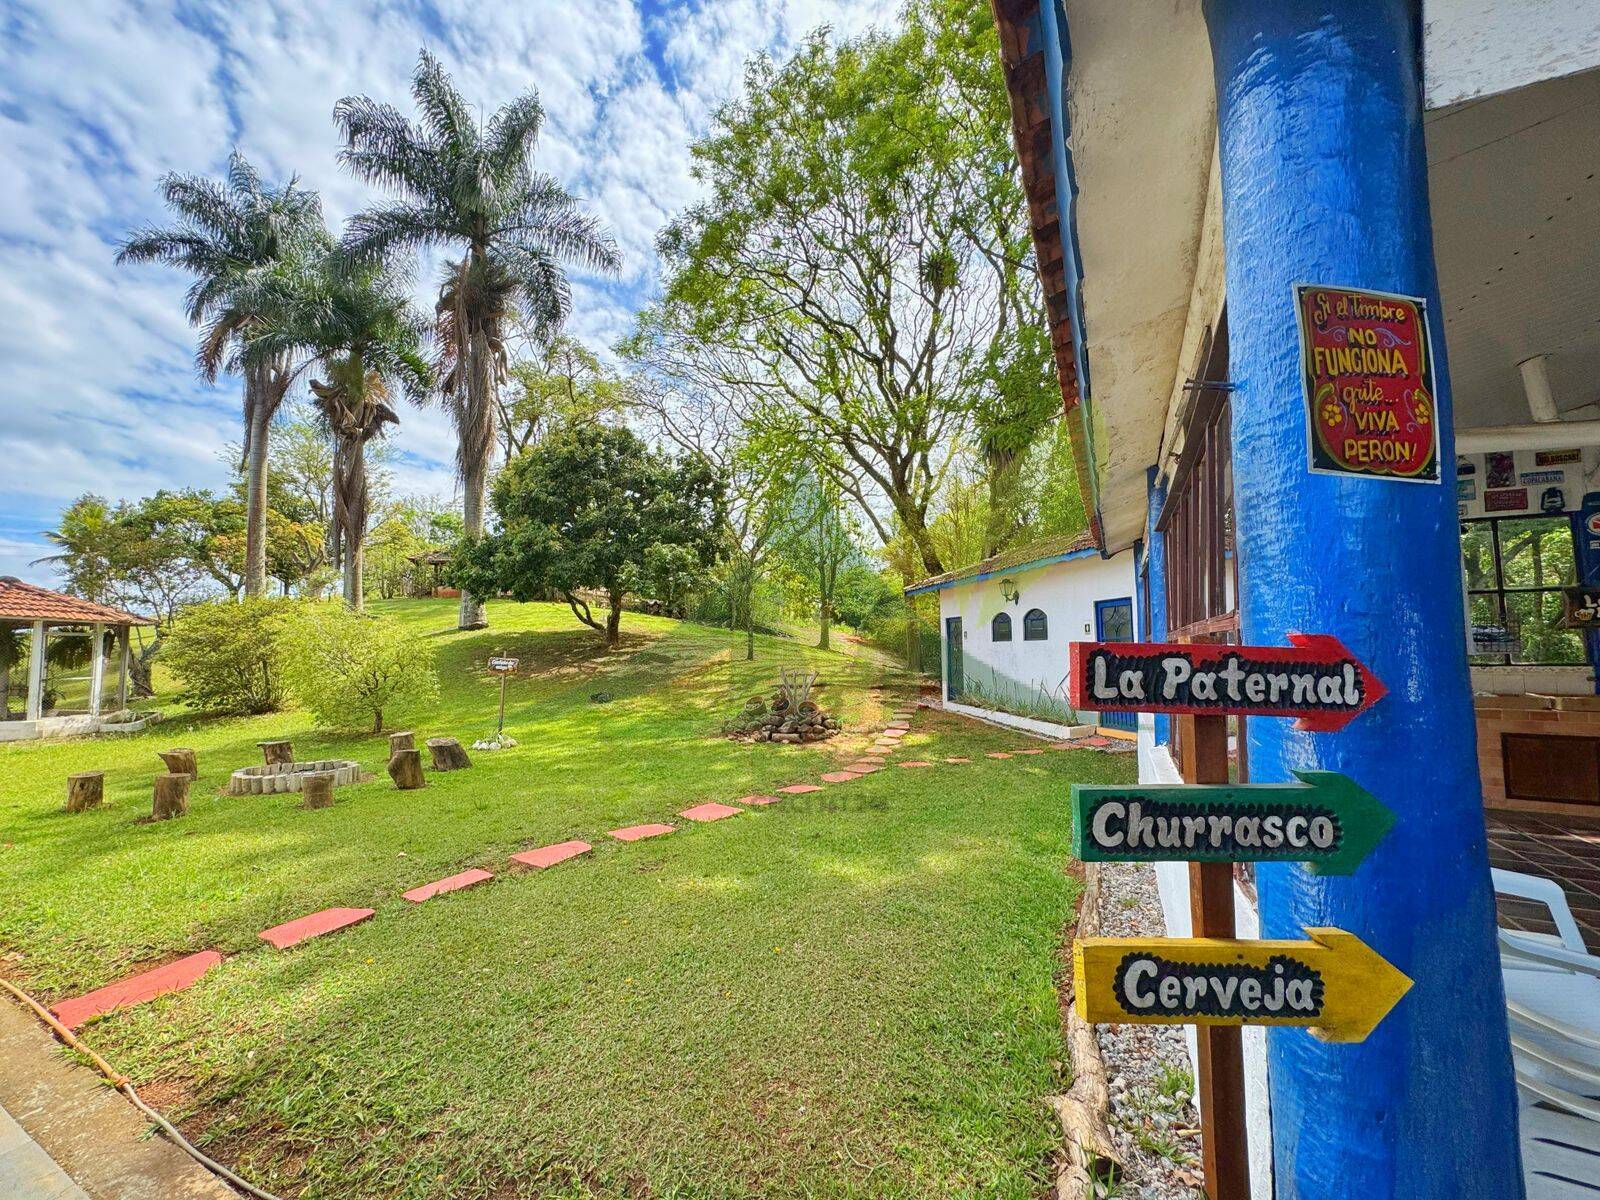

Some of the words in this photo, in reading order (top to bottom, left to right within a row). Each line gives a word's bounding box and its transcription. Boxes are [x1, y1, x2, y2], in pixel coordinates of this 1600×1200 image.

[1314, 293, 1330, 325] Si
[1336, 298, 1347, 316] el
[1349, 327, 1377, 346] NO
[1314, 347, 1408, 376] FUNCIONA
[1093, 656, 1145, 700] La
[1162, 657, 1360, 706] Paternal
[1093, 802, 1336, 849] Churrasco
[1124, 959, 1315, 1011] Cerveja
